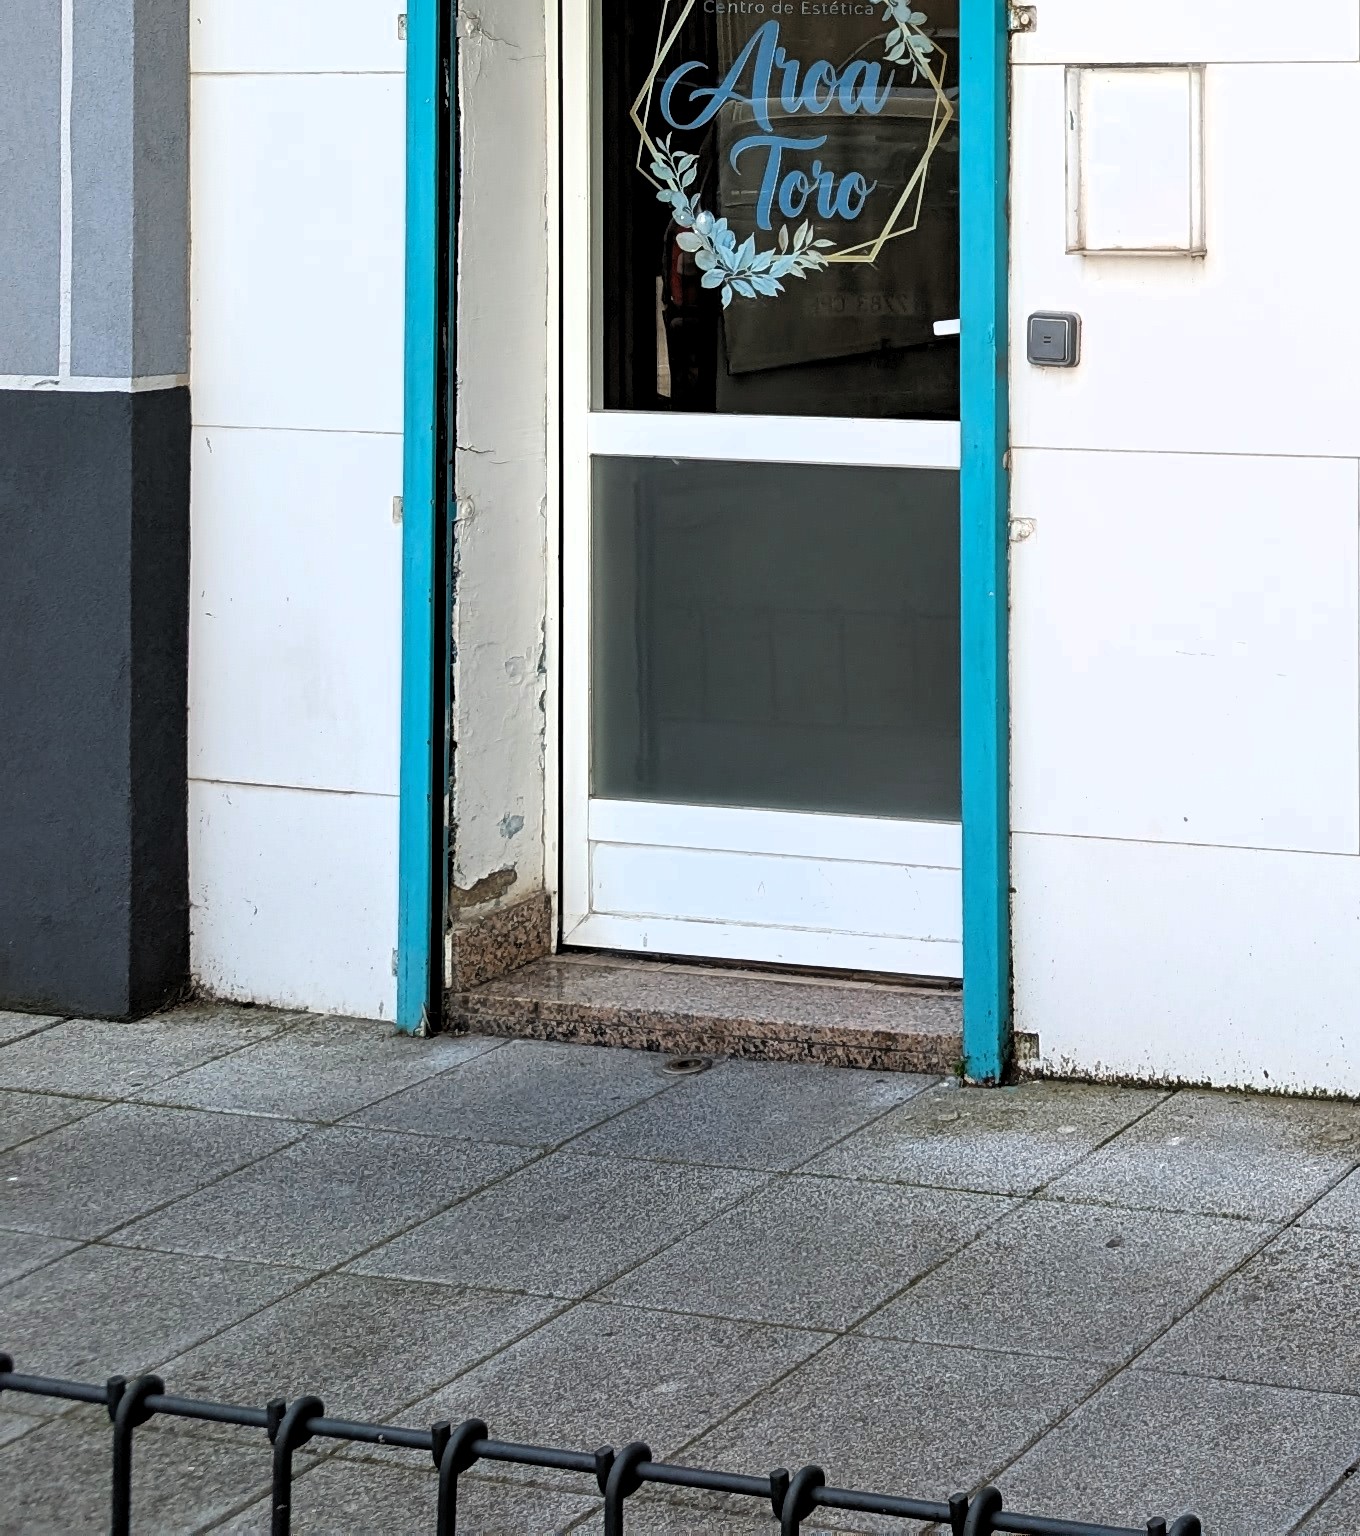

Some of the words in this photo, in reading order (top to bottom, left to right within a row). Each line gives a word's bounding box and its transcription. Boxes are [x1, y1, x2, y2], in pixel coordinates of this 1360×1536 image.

[703, 0, 766, 15] Centro
[771, 0, 795, 15] de
[801, 0, 875, 16] Estética
[659, 19, 895, 133] Aroa
[729, 134, 878, 231] Toro
